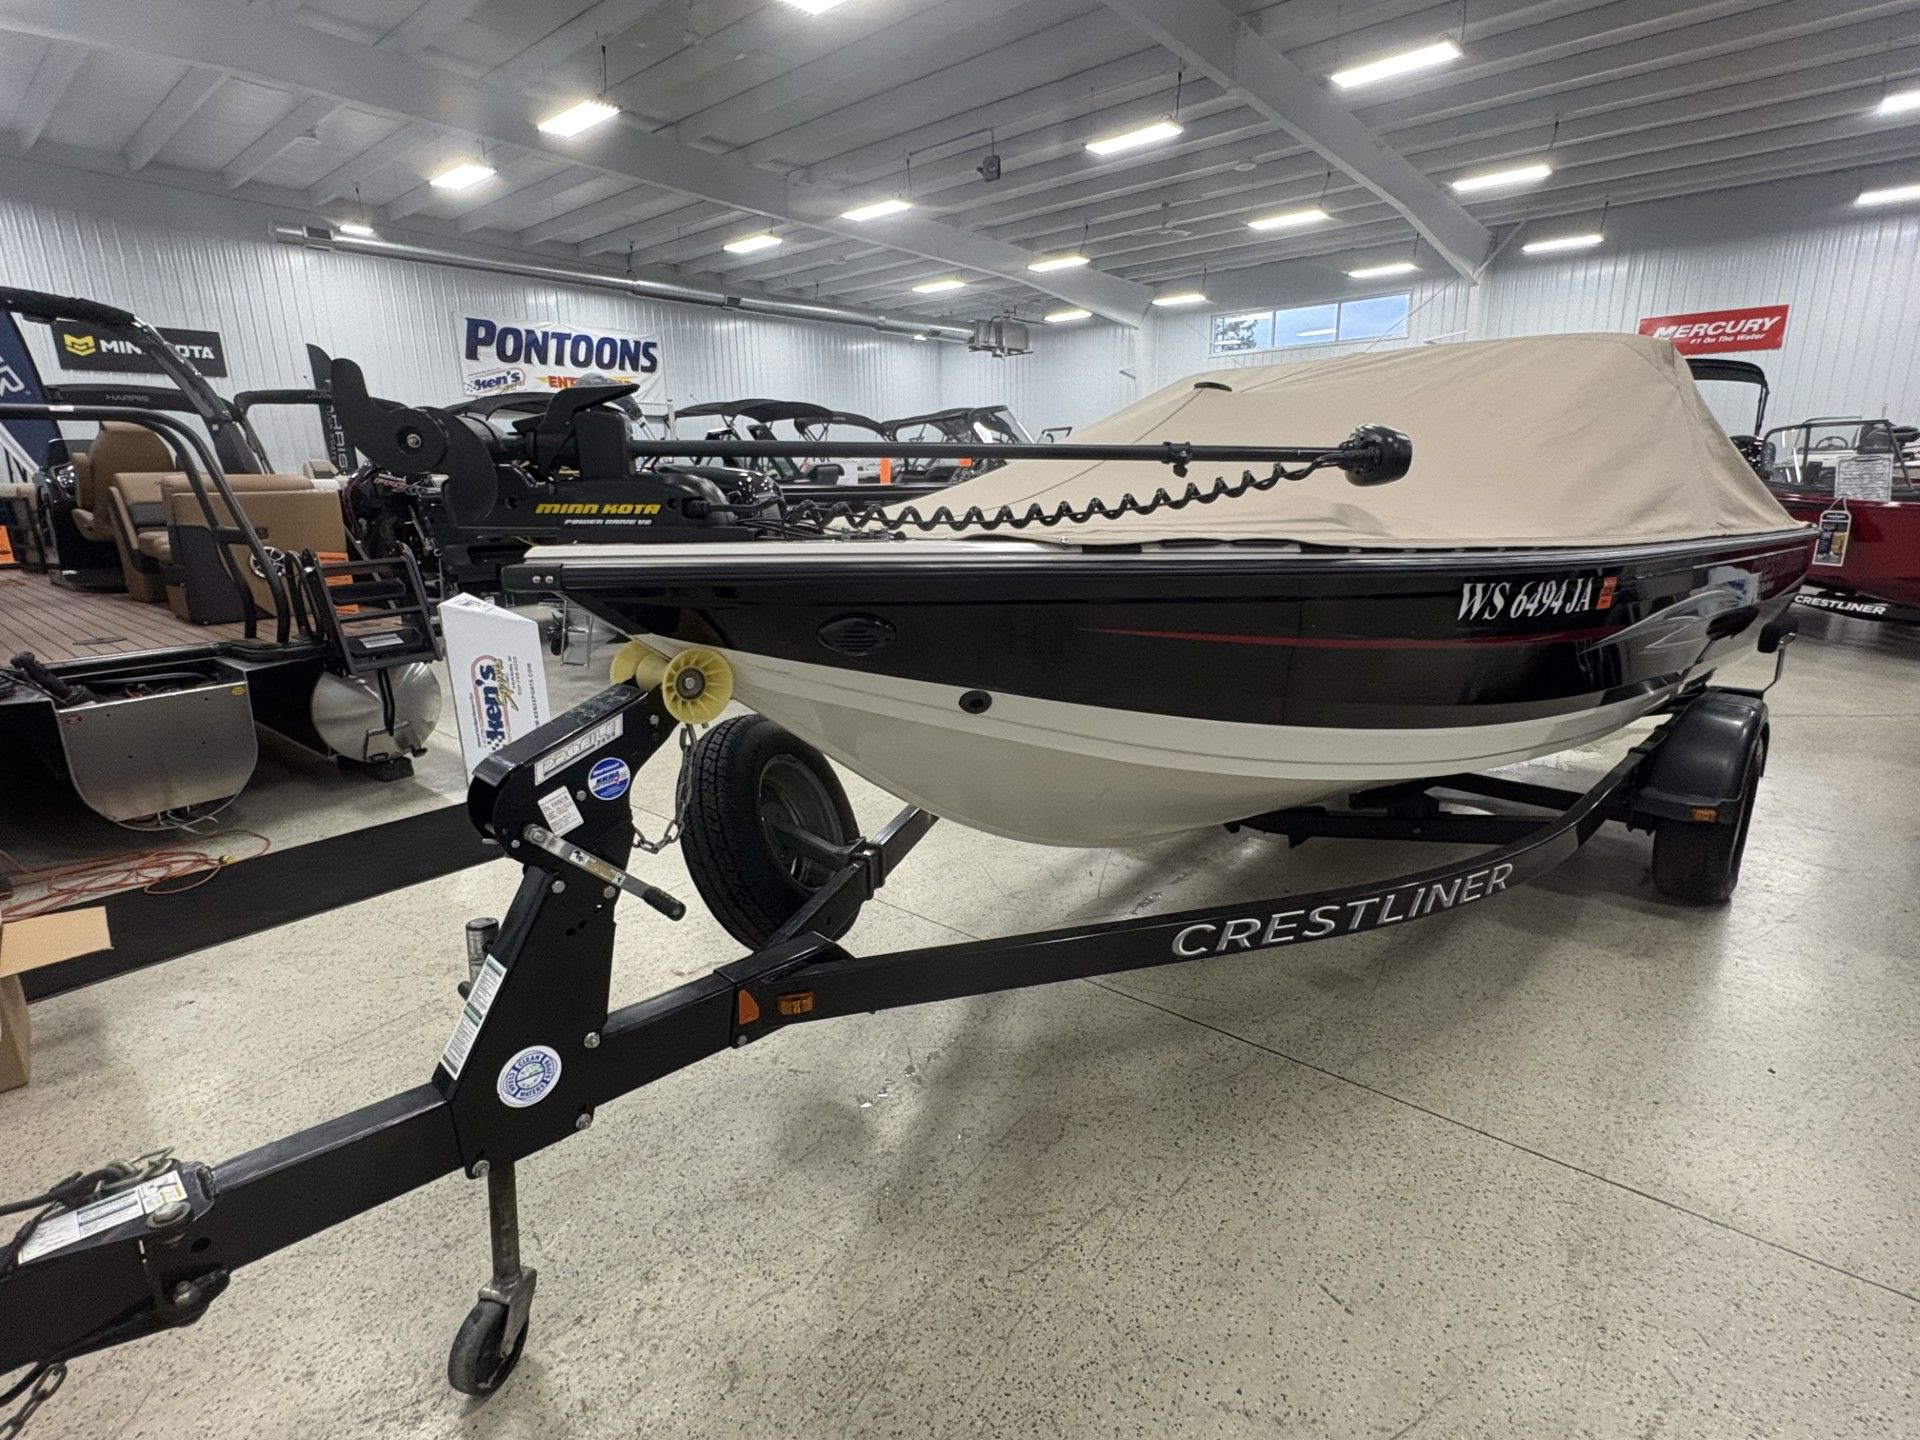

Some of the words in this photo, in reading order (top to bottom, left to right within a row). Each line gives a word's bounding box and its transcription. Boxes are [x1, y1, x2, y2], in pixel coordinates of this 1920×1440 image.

[1653, 316, 1781, 341] MERCURY
[1737, 333, 1766, 341] Water
[100, 339, 146, 355] MIN
[172, 344, 215, 360] OTA
[465, 317, 658, 373] PONTOONS
[602, 503, 662, 514] KOTA
[1457, 582, 1512, 621] WS
[1510, 580, 1569, 619] 6494
[1565, 577, 1594, 614] JA
[1794, 595, 1887, 615] CRESTLINER
[1172, 863, 1514, 957] CRESTLINER
